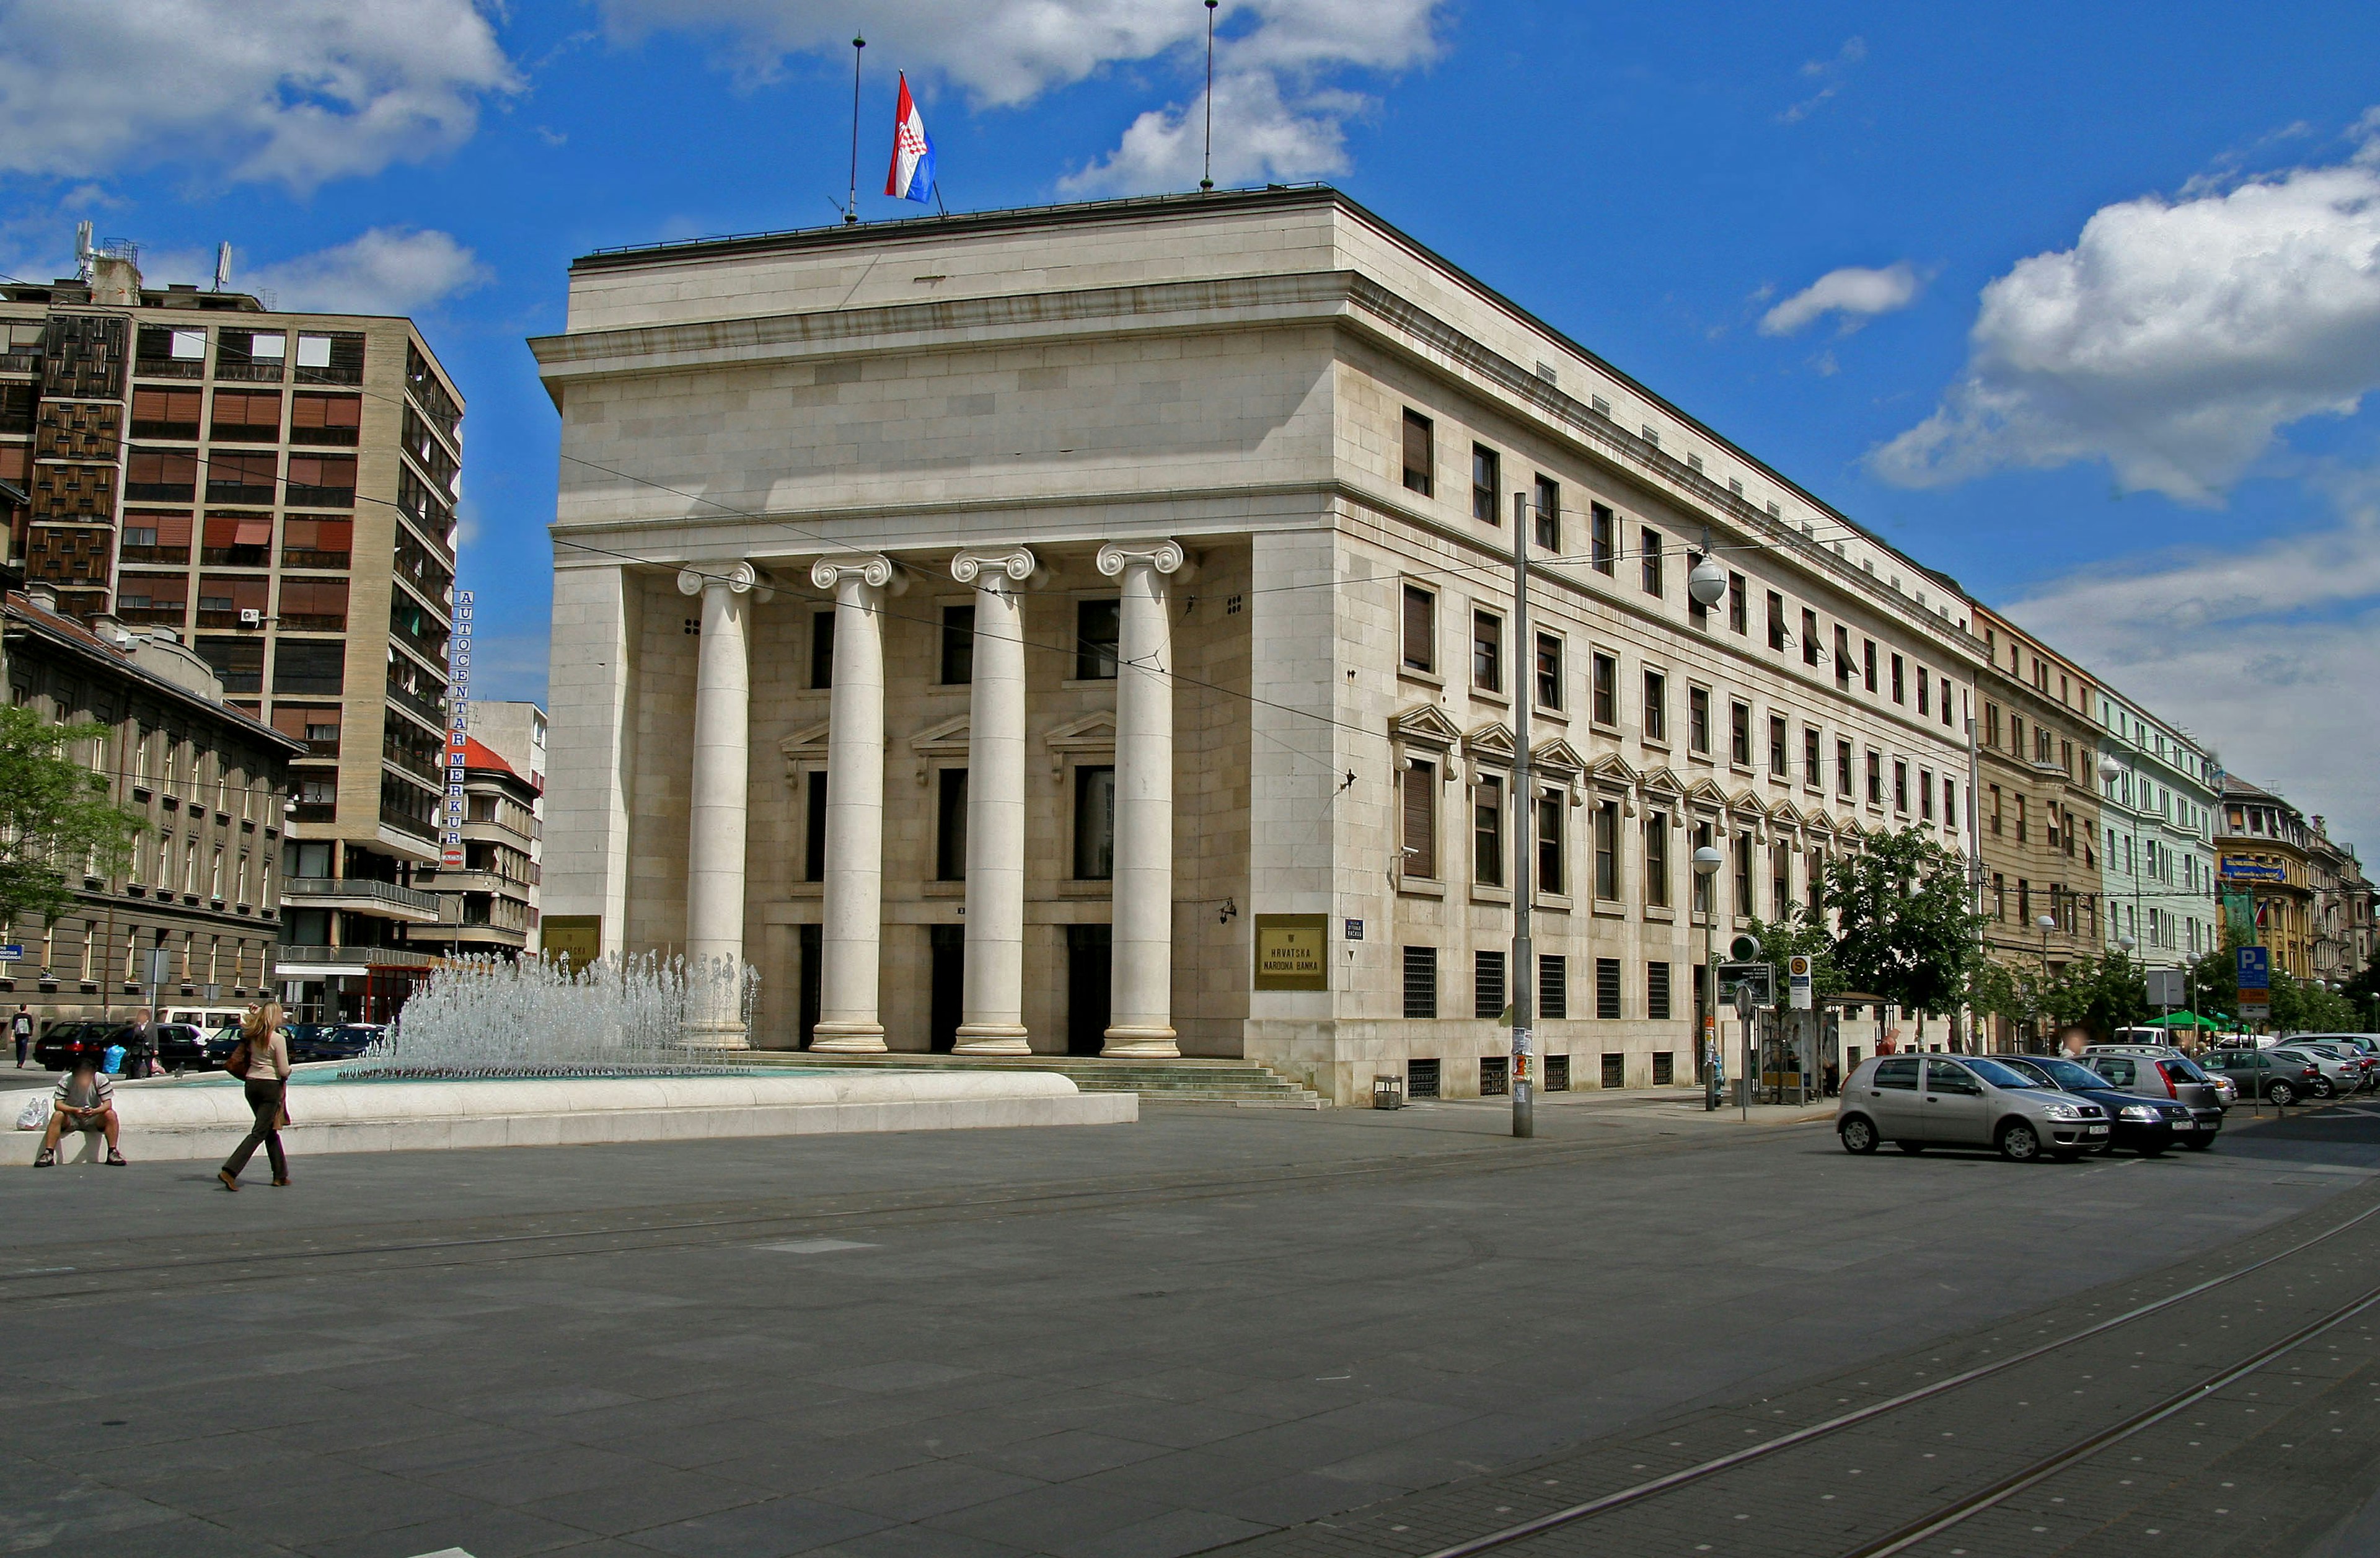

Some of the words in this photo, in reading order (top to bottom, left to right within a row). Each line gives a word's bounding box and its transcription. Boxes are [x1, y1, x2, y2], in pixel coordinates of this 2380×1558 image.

[453, 593, 472, 745] AUTOCENTAR
[447, 755, 464, 844] MERKUR
[1271, 949, 1310, 958] HRVATSKA
[2241, 950, 2255, 968] P
[1264, 961, 1293, 970] NARODNA
[1297, 962, 1318, 971] BANKA
[1794, 962, 1802, 971] S
